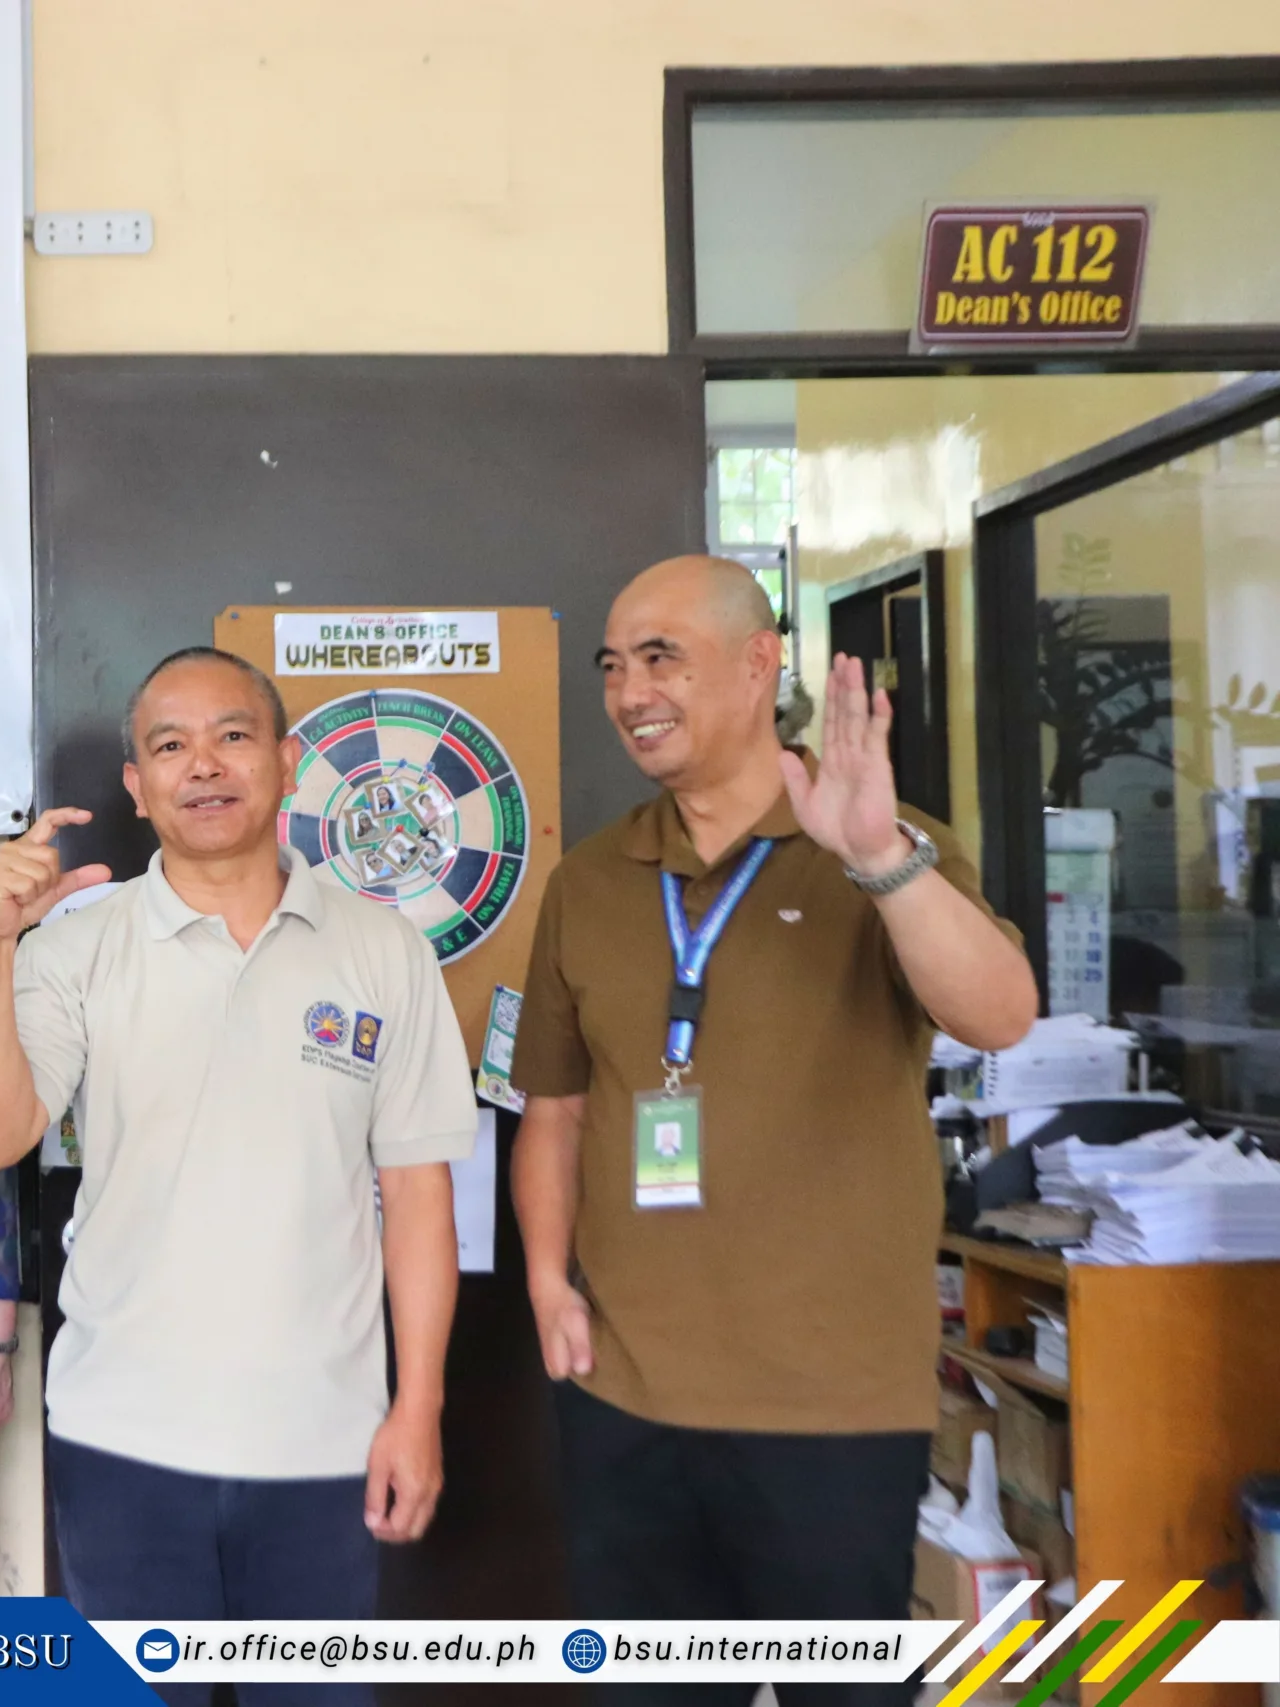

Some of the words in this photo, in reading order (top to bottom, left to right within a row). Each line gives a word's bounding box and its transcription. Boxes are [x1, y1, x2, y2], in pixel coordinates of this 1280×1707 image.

[952, 224, 1018, 284] AC
[1030, 224, 1119, 284] 112
[935, 290, 1031, 325] Dean's
[1039, 289, 1122, 325] Office
[320, 625, 386, 640] DEAN'S
[395, 624, 459, 640] OFFICE
[285, 642, 493, 669] WHEREABOUTS
[454, 720, 472, 738] ON
[471, 733, 500, 769] LEAVE
